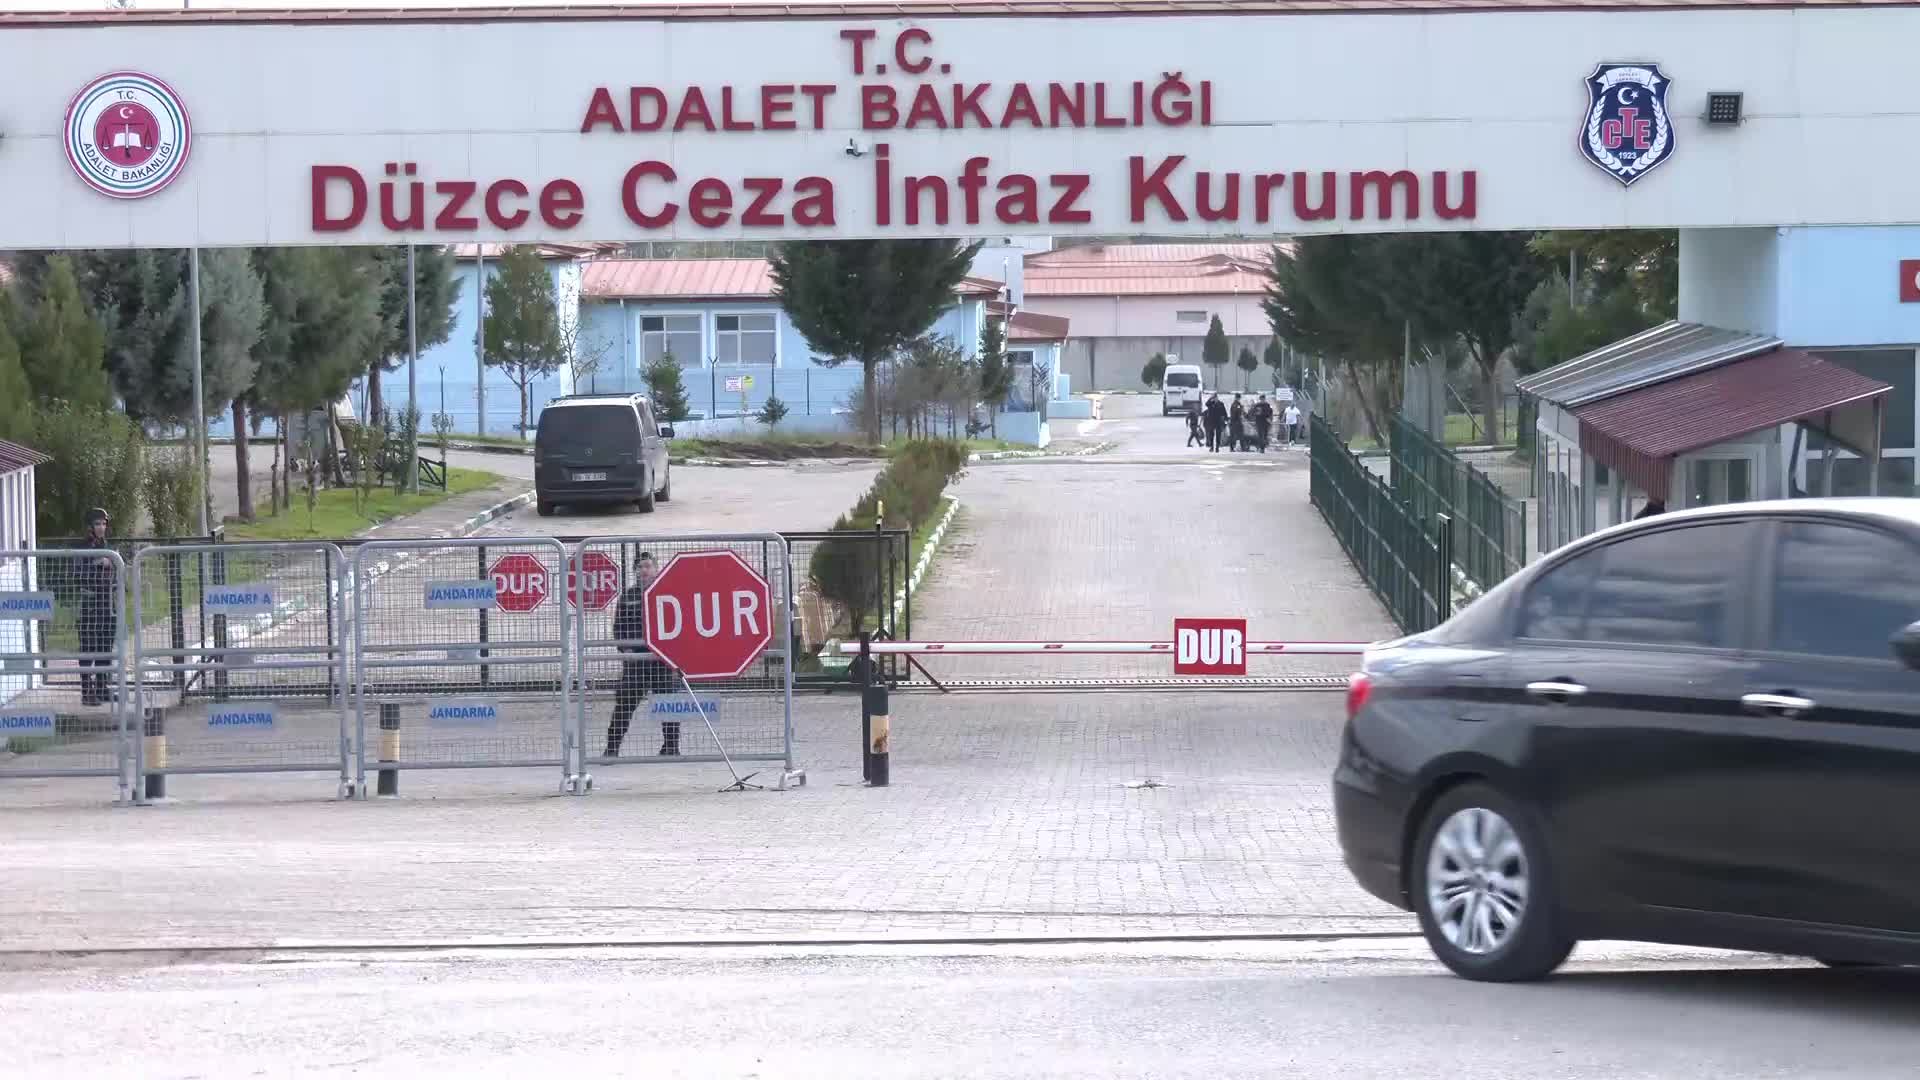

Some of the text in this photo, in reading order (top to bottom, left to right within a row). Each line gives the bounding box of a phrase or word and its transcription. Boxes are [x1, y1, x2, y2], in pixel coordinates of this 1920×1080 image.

[840, 28, 950, 75] T.C.
[117, 90, 138, 100] T.C.
[582, 72, 1211, 132] ADALET BAKANLIĞI
[1602, 107, 1651, 149] CTE
[83, 142, 172, 181] ADALET BAKANLIĞI
[1618, 151, 1637, 161] 1923
[311, 143, 1478, 232] Düzce Ceza İnfaz Kurumu
[429, 587, 495, 600] JANDARMA
[491, 572, 545, 595] DUR
[0, 599, 51, 611] NDARMA
[655, 590, 761, 641] DUR
[1177, 628, 1243, 666] DUR
[429, 706, 496, 719] JANDARMA
[652, 701, 718, 713] JANDARMA
[208, 712, 273, 726] JANDARMA
